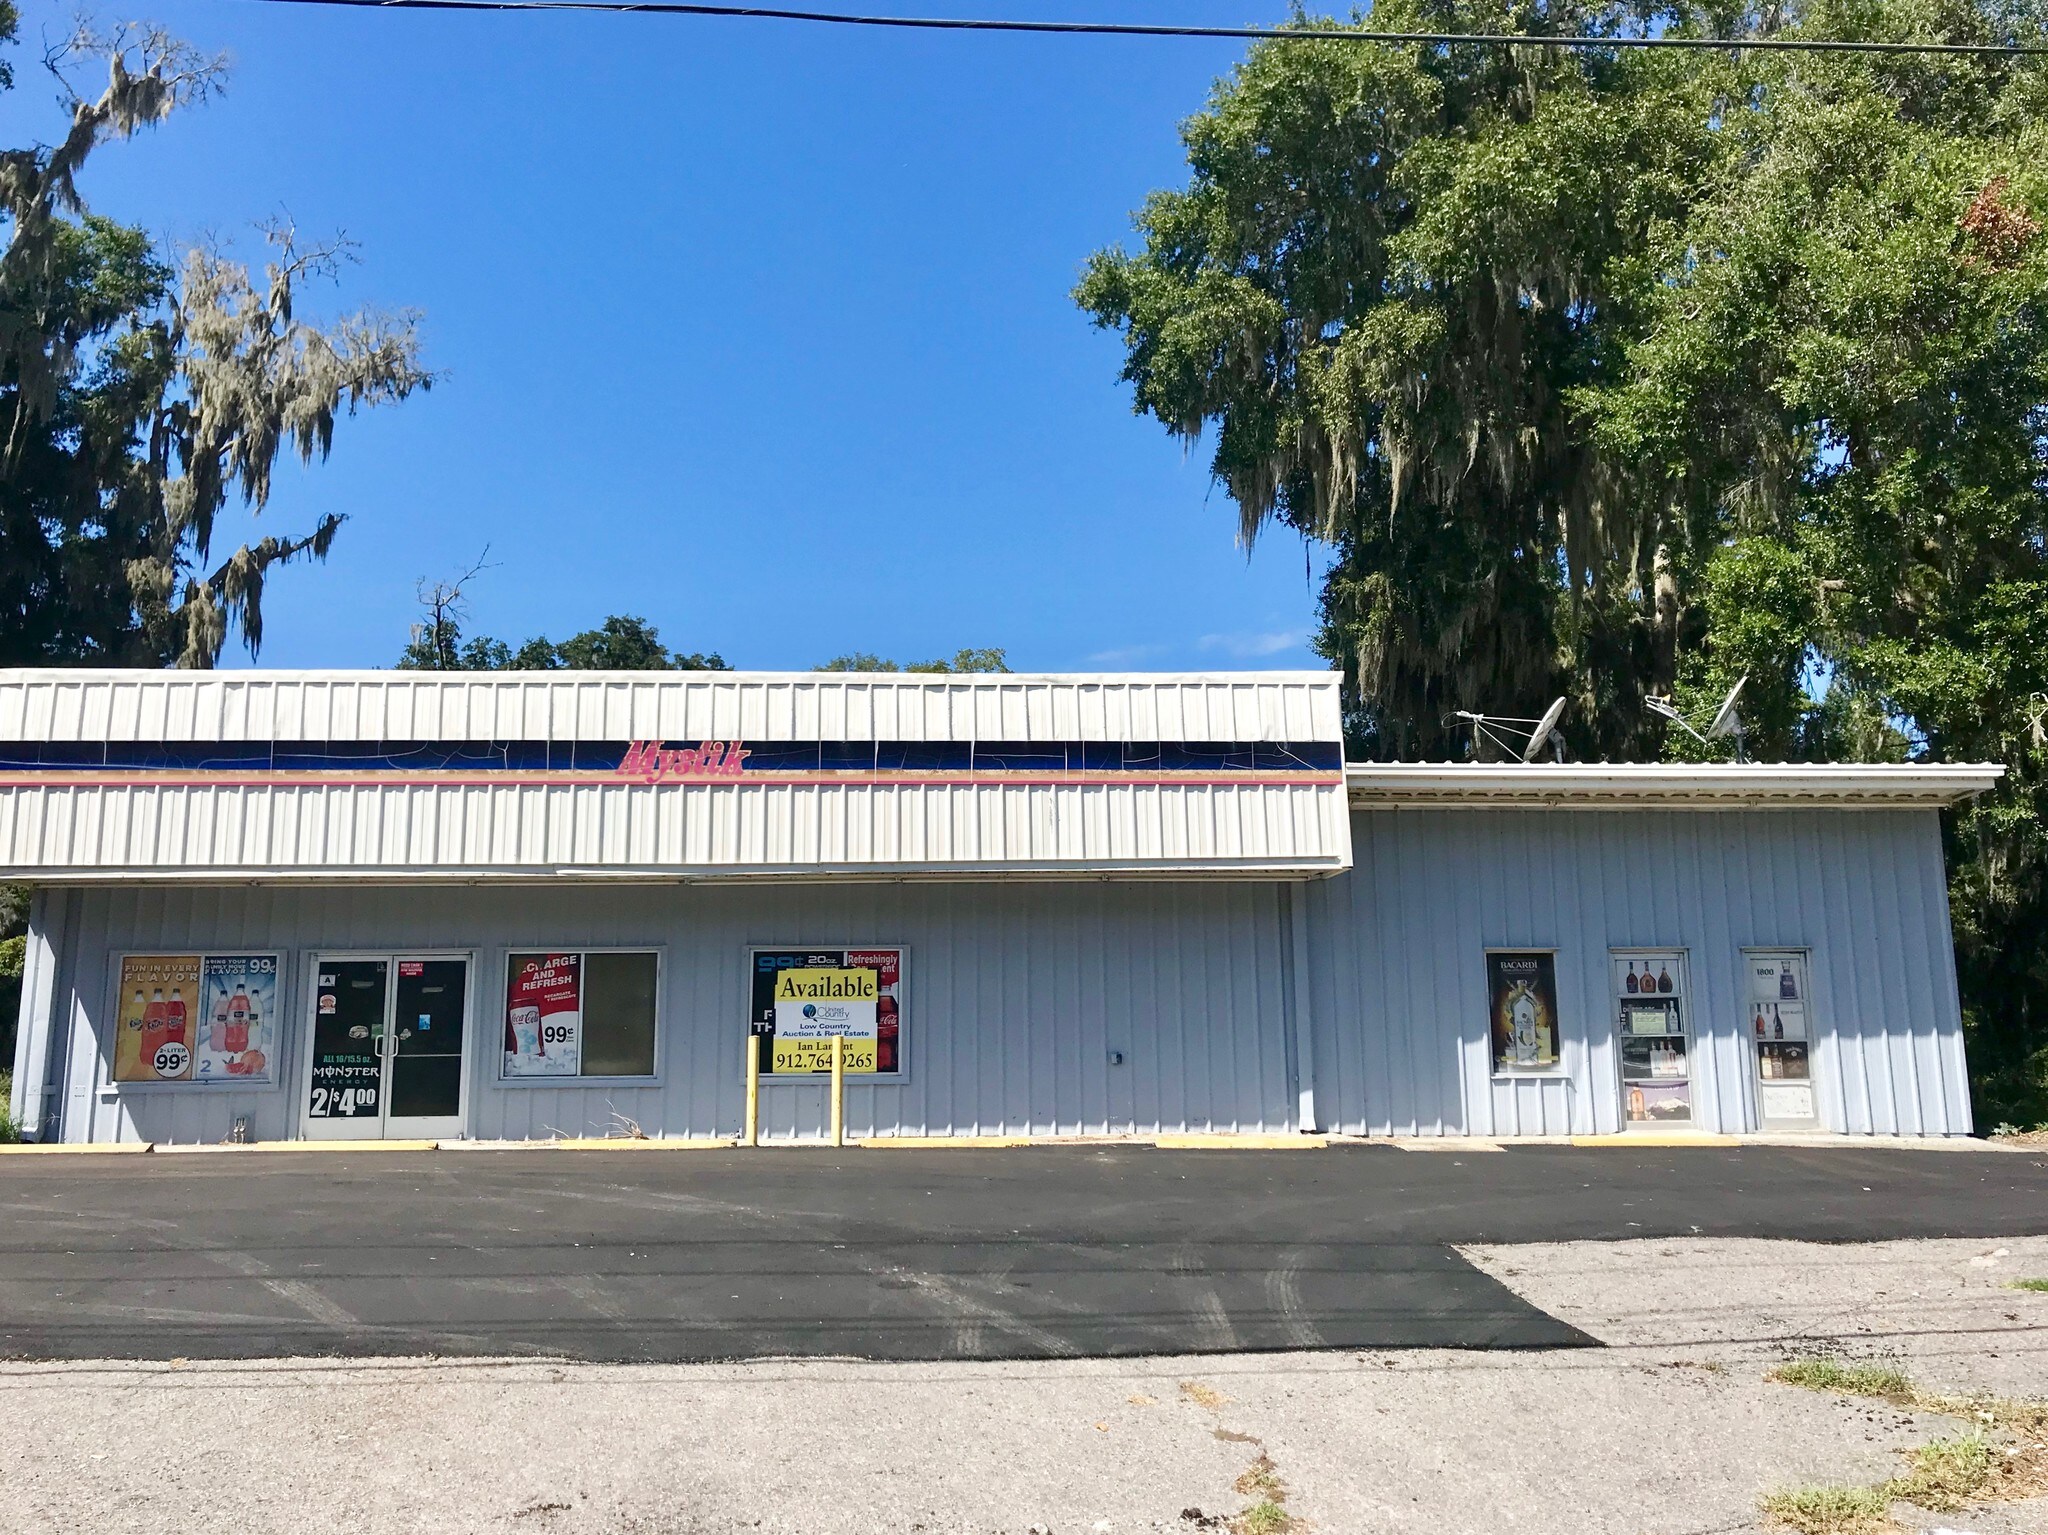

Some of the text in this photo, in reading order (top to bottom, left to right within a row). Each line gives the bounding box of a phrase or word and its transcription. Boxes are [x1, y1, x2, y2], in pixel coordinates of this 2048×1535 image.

[615, 740, 752, 784] Mystik
[848, 954, 897, 965] Refreshingly
[249, 959, 275, 974] 99¢
[1756, 968, 1774, 976] 1800
[124, 973, 198, 982] FLAVOR
[532, 970, 555, 980] AND
[522, 975, 572, 991] REFRESH
[780, 976, 873, 997] Available
[545, 1026, 574, 1043] 99¢
[798, 1042, 813, 1050] Ian
[156, 1054, 188, 1070] 99¢
[200, 1059, 211, 1072] 2
[323, 1055, 334, 1063] ALL
[777, 1053, 872, 1068] 912.764265
[313, 1066, 379, 1078] MONSTER
